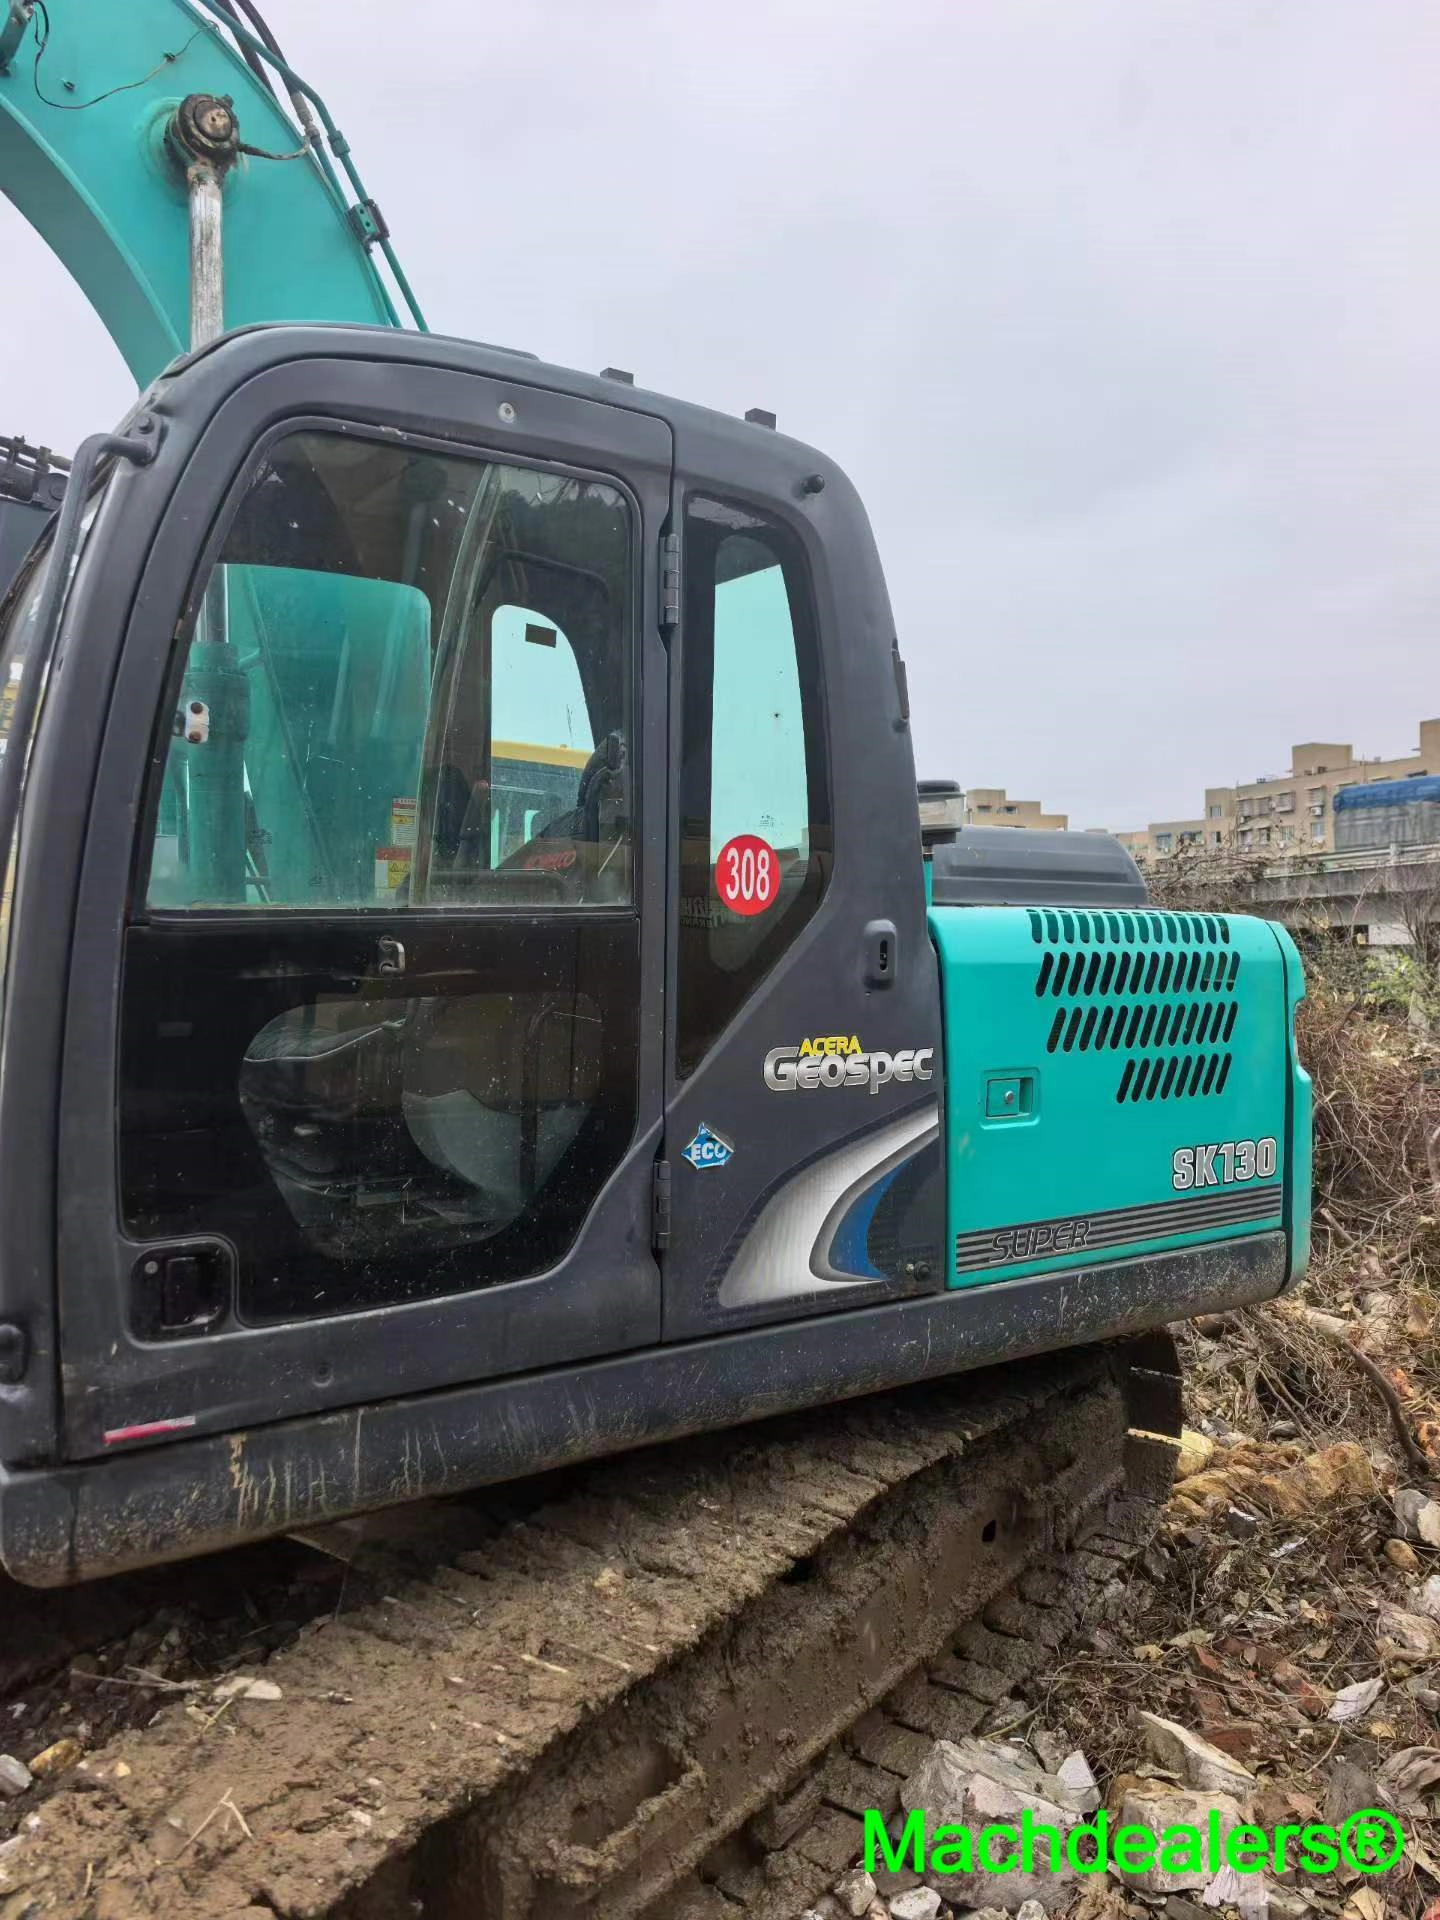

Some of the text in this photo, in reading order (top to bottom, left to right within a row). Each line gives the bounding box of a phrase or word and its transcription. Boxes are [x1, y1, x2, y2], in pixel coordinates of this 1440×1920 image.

[725, 847, 771, 902] 308
[799, 1035, 863, 1056] ACERA
[690, 1142, 727, 1161] ECO
[1172, 1137, 1277, 1190] SK130
[989, 1219, 1091, 1263] SUPER
